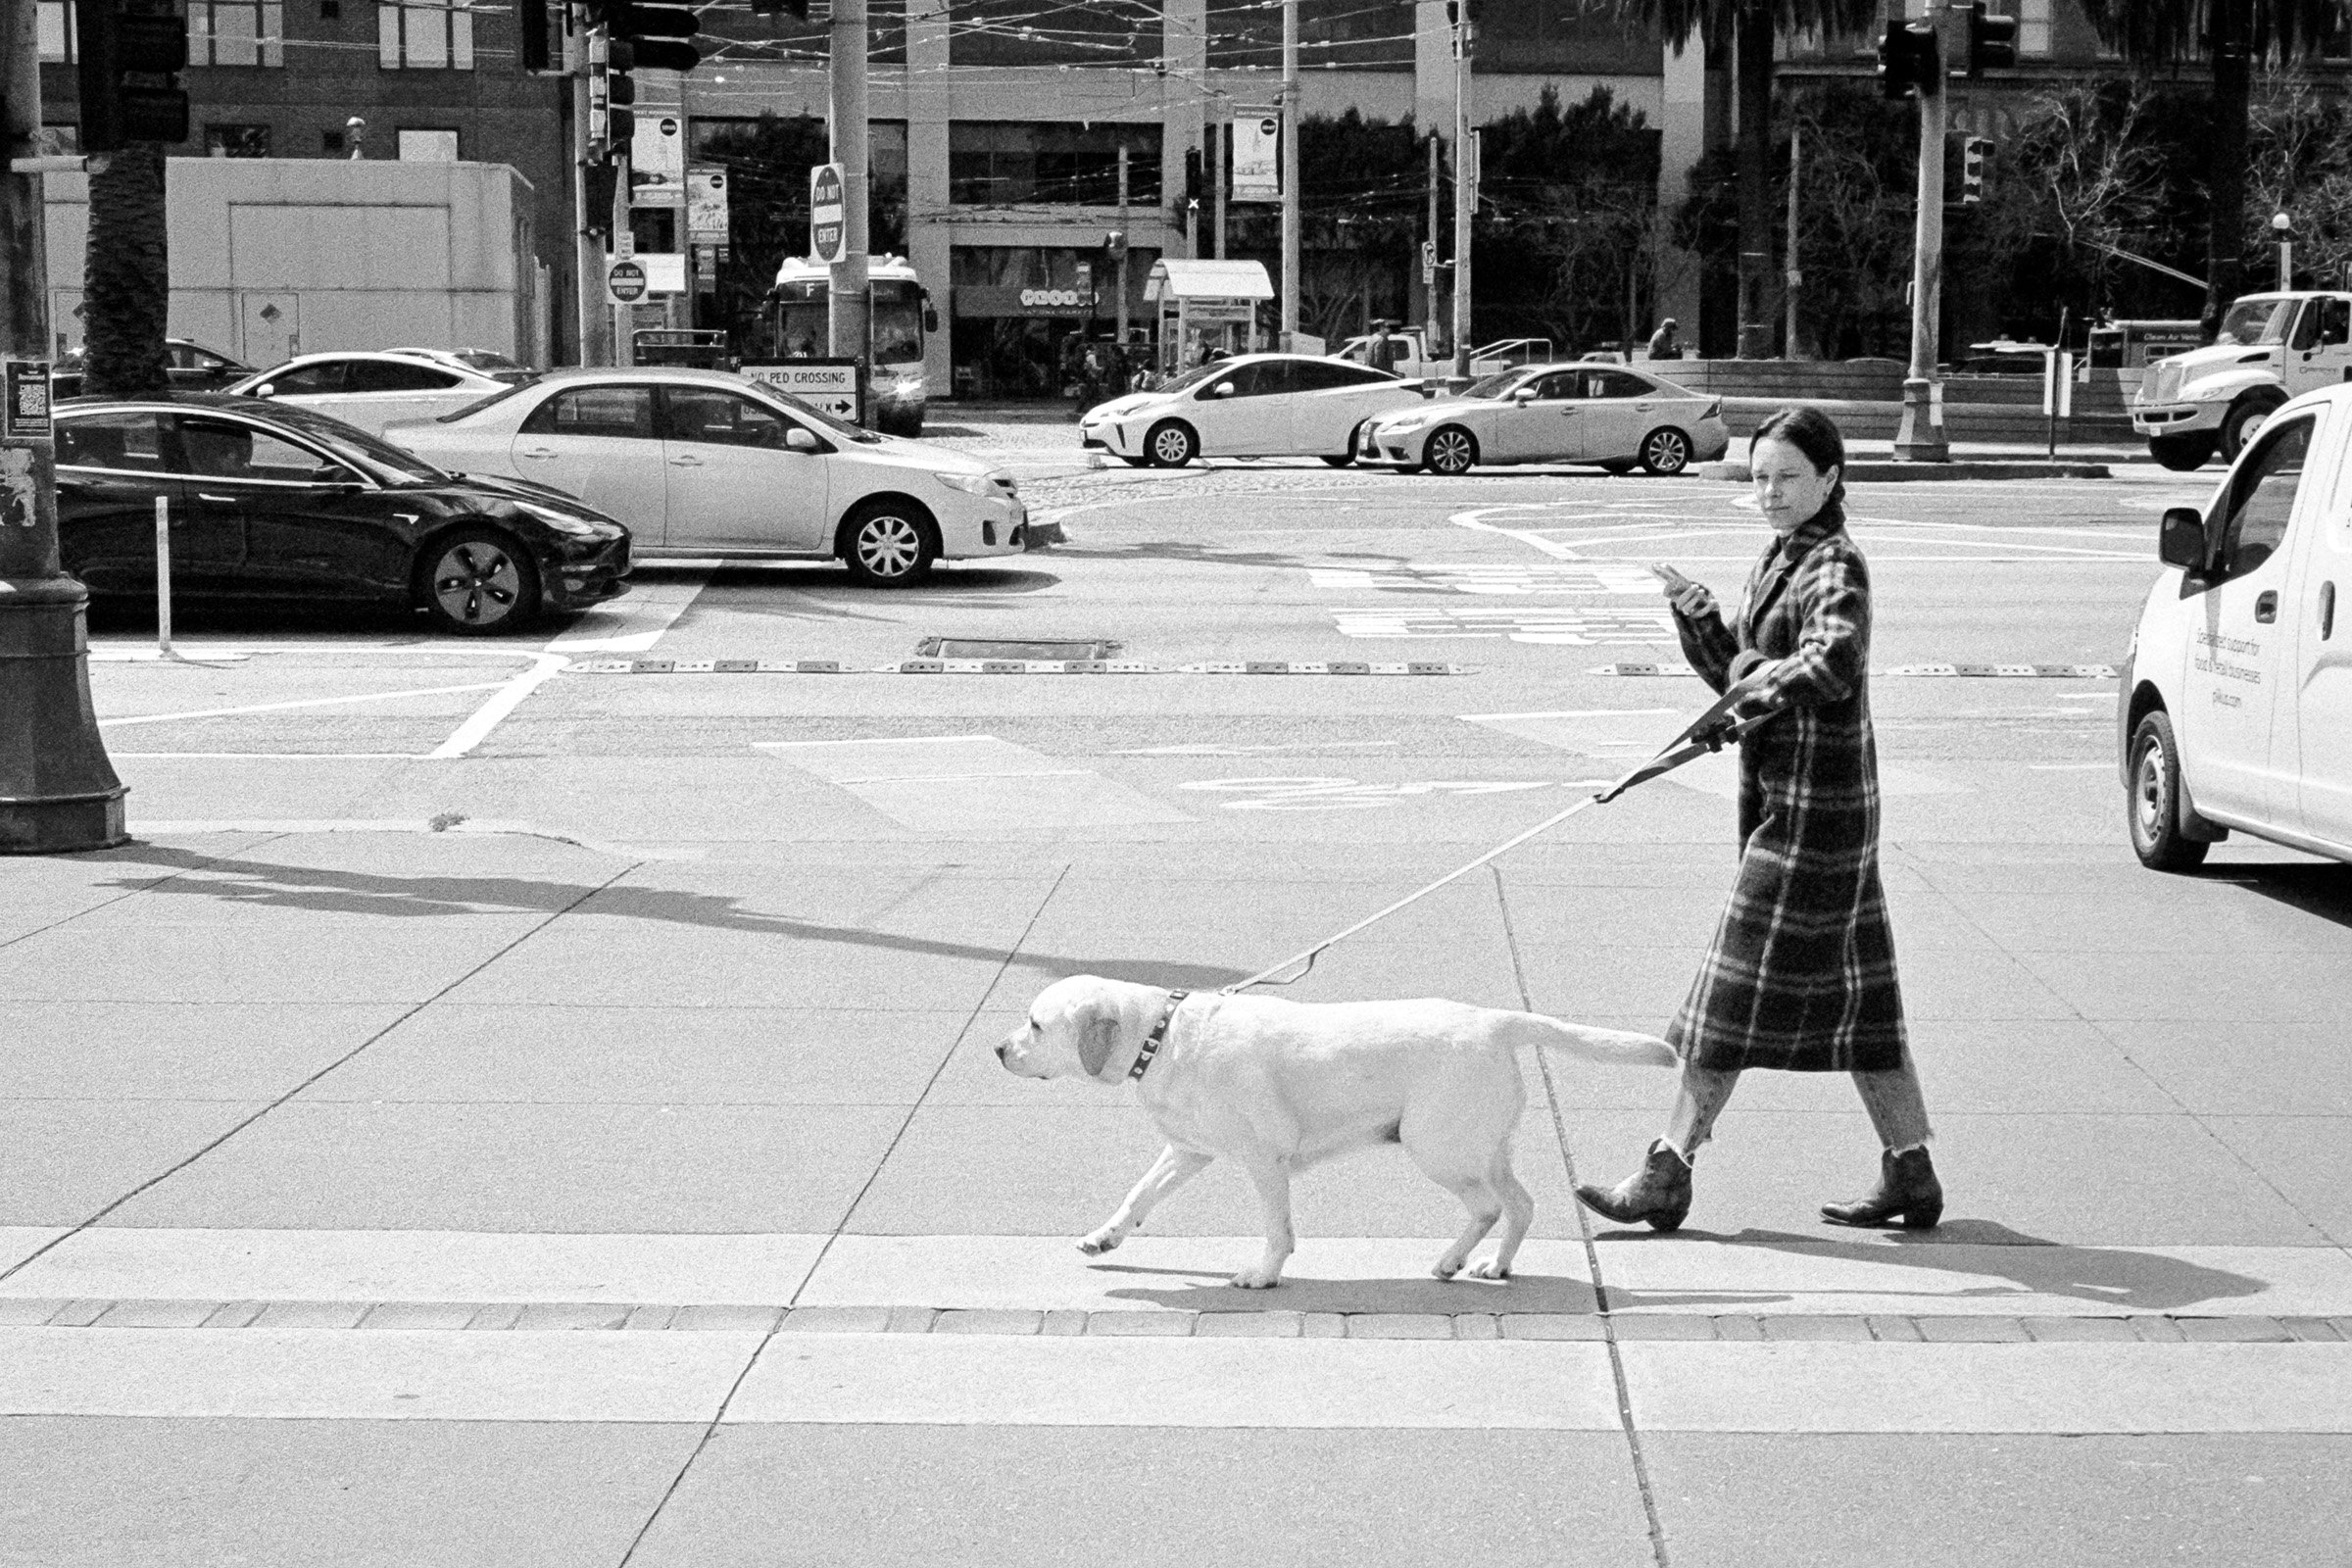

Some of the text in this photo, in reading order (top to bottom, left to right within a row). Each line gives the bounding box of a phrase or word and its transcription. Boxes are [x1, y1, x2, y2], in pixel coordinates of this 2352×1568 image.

[815, 184, 840, 202] DO NOT
[818, 227, 838, 243] ENTER
[616, 286, 638, 295] ENTER
[807, 283, 815, 297] F
[769, 372, 790, 384] PED
[794, 372, 846, 384] CROSSING
